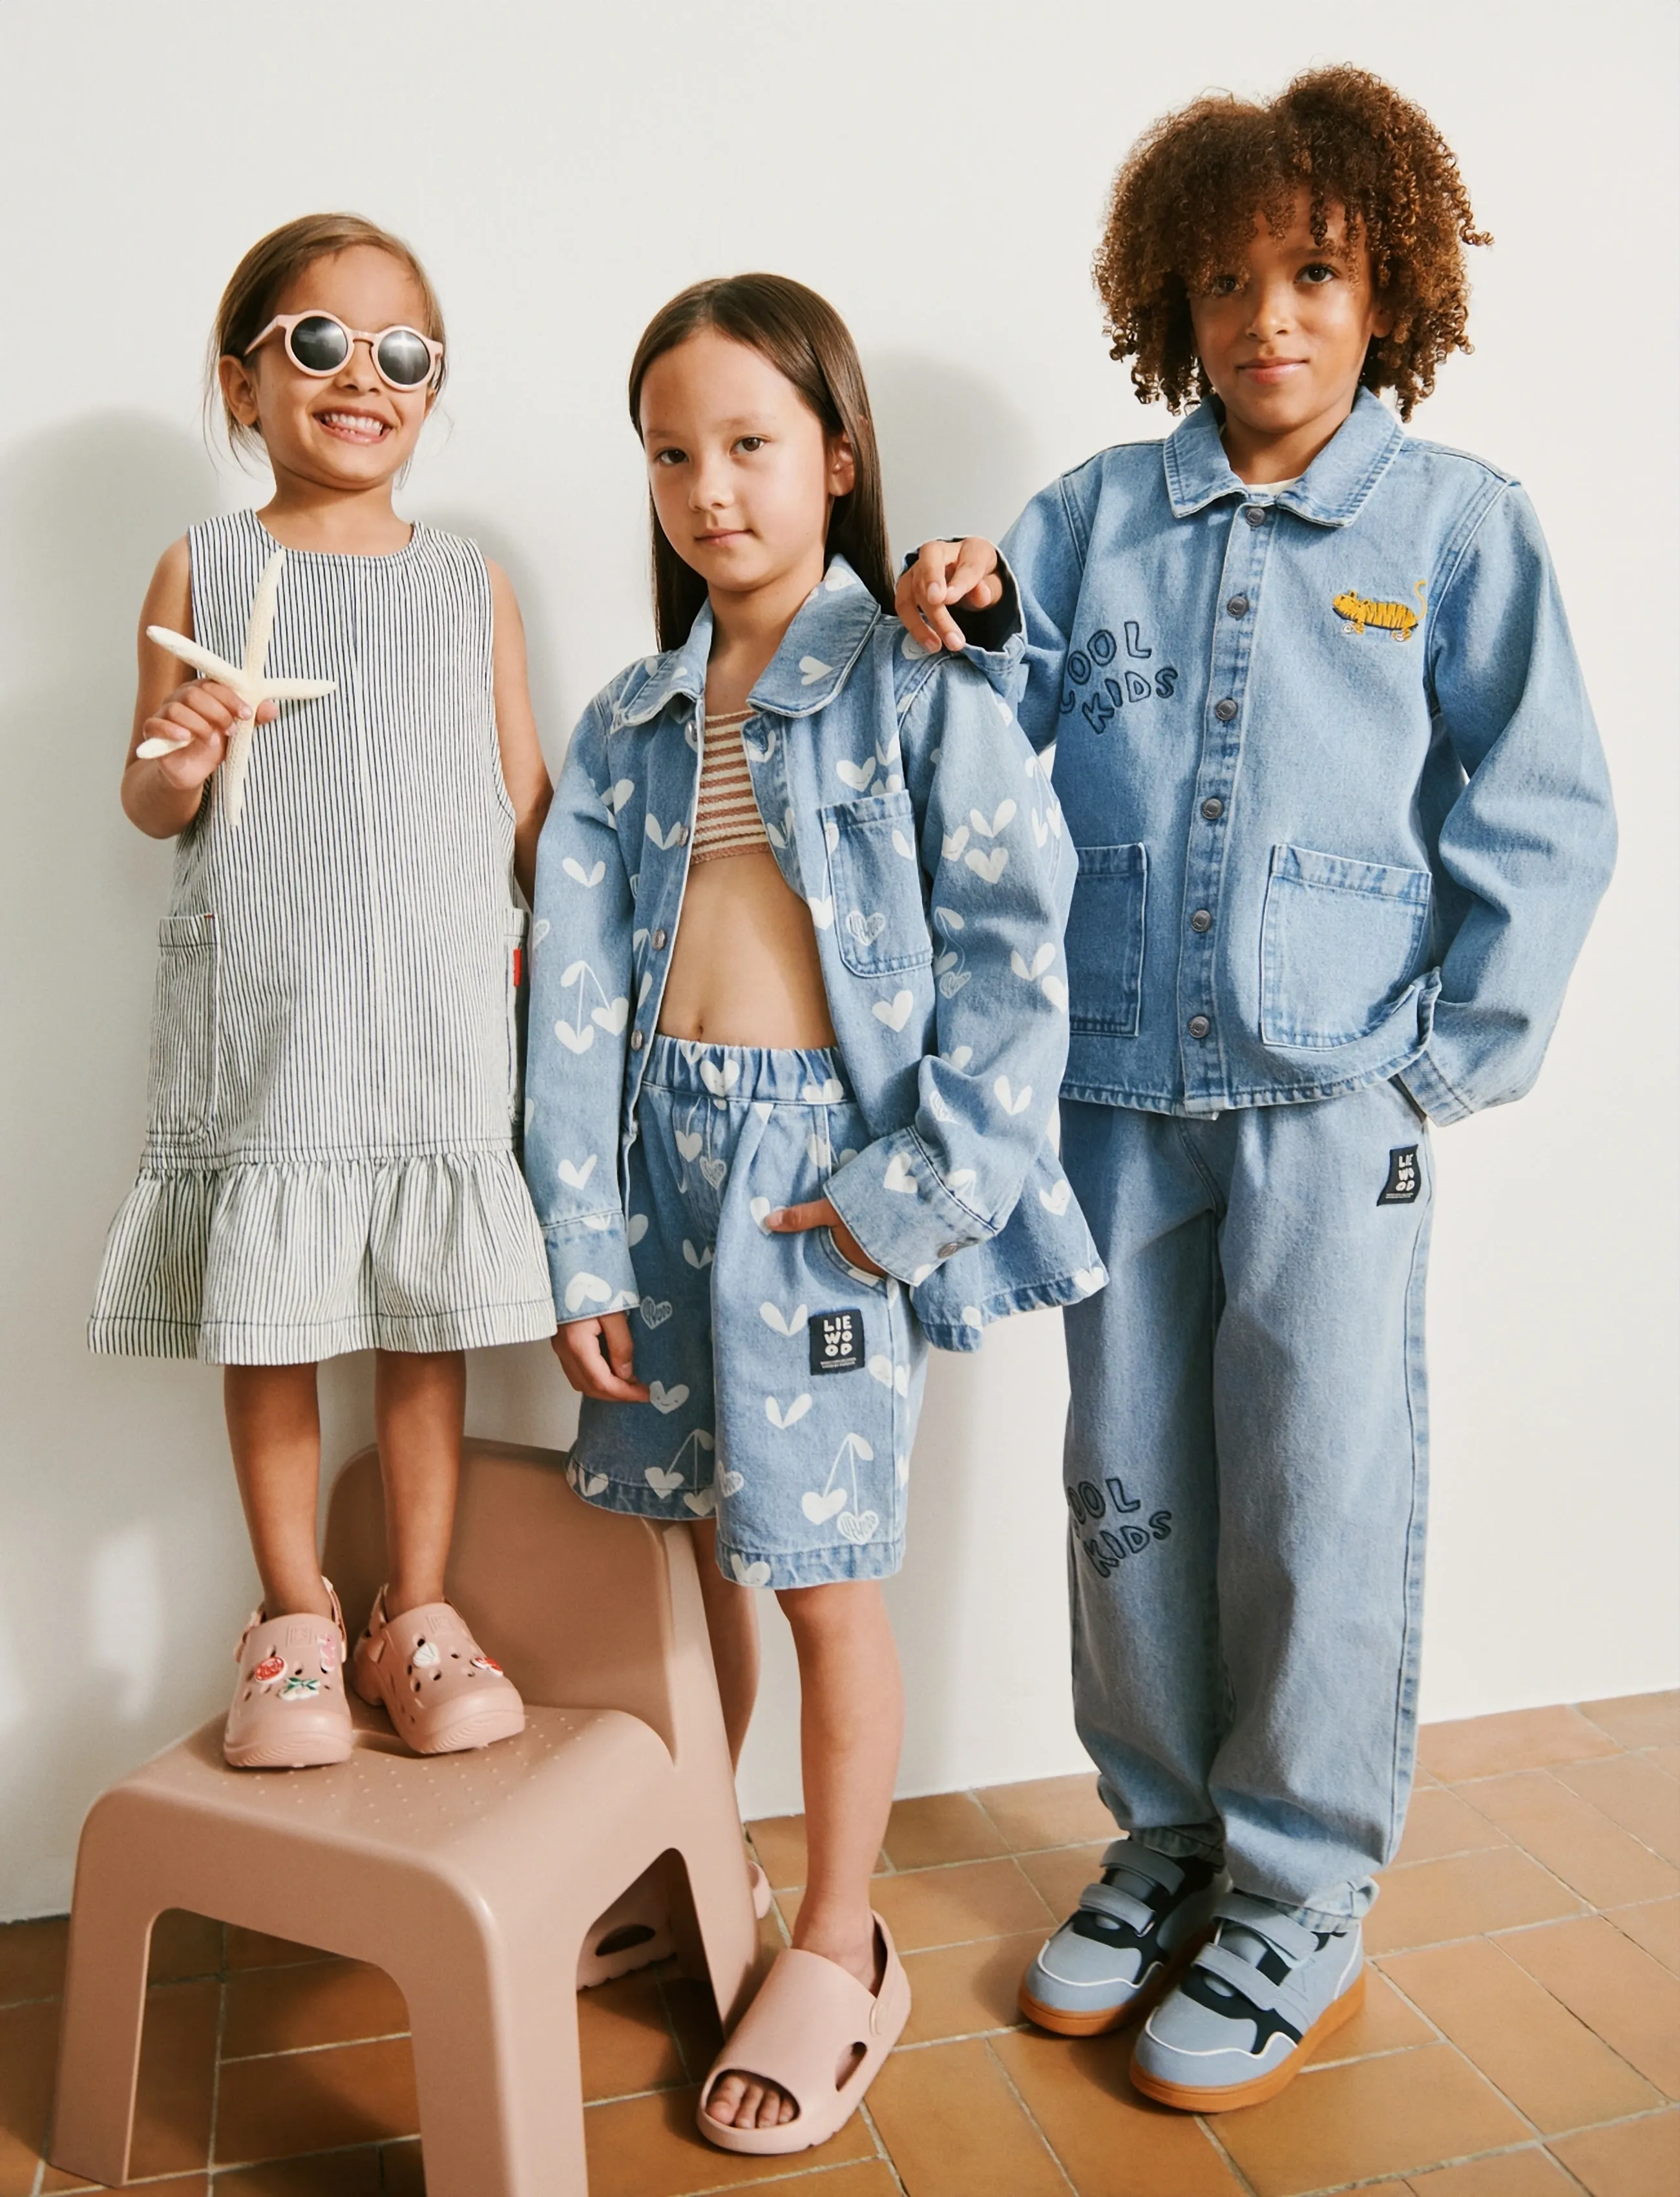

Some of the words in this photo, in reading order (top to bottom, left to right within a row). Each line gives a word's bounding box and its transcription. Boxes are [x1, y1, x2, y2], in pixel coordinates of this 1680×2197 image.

[1082, 667, 1179, 735] KIDS
[1396, 1180, 1415, 1191] OD
[823, 1315, 852, 1332] LIE
[824, 1330, 853, 1344] WO
[824, 1343, 853, 1357] OD
[1067, 1476, 1141, 1539] OOL
[1084, 1510, 1172, 1578] KIDS
